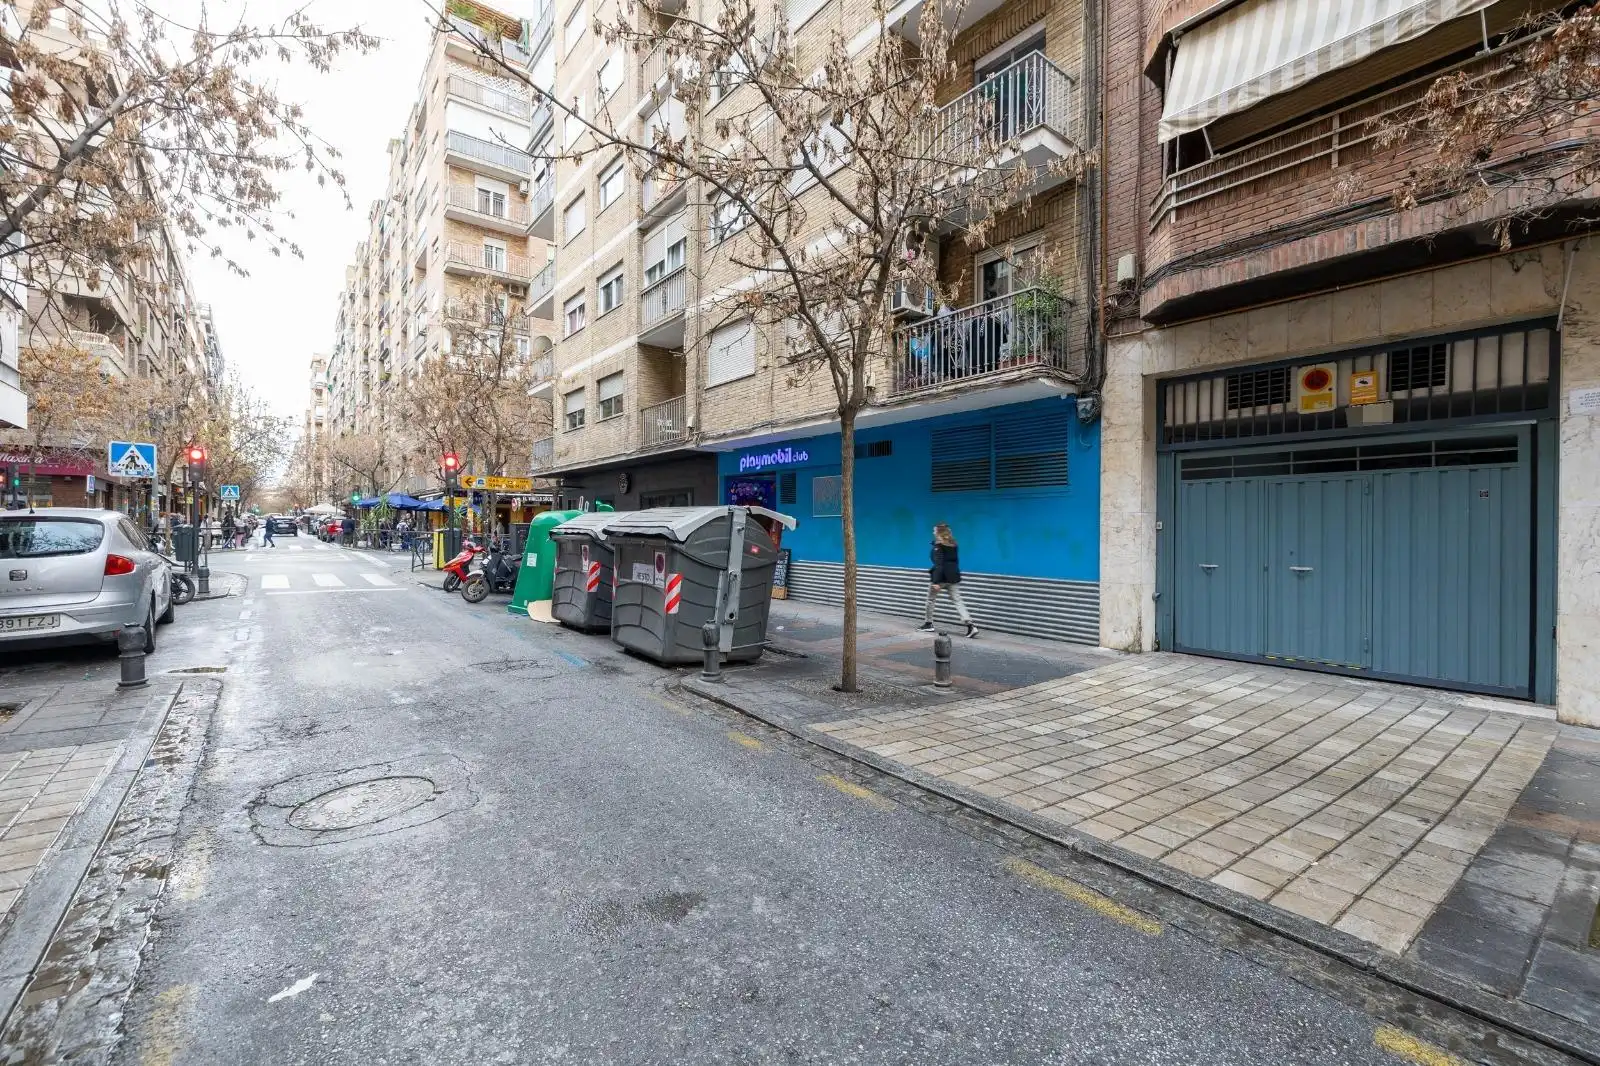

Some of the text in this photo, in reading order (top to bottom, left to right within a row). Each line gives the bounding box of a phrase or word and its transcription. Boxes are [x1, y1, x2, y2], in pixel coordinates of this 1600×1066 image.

[739, 447, 809, 472] playmobil club
[28, 616, 55, 627] FZJ
